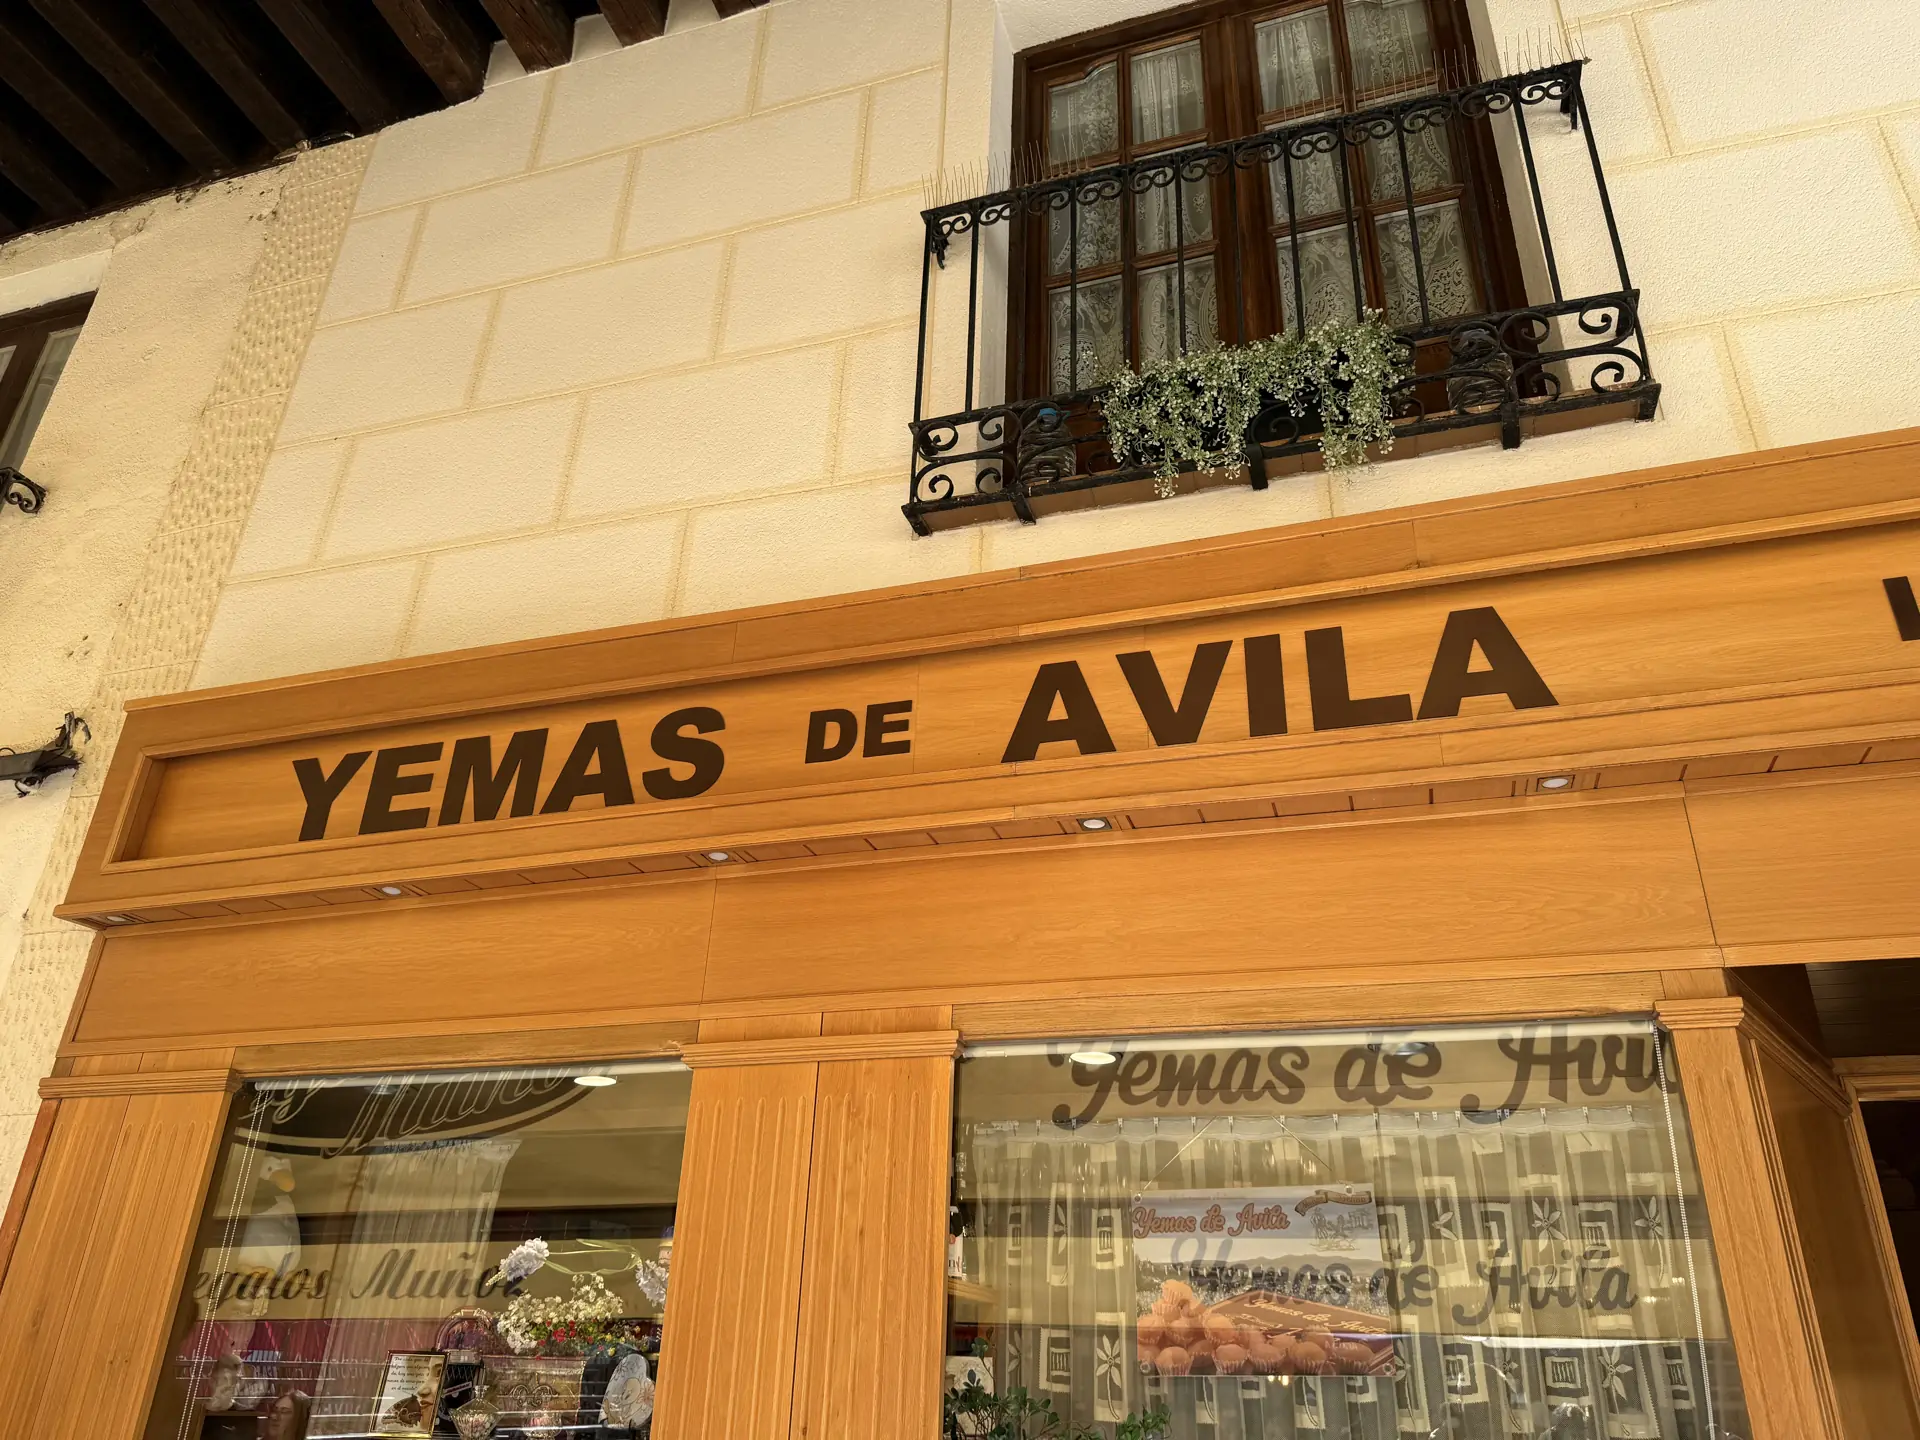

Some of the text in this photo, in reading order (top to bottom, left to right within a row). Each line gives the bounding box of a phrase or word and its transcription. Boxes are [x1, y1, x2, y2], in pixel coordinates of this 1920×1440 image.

[292, 605, 1560, 842] YEMAS DE AVILA
[1047, 1042, 1309, 1130] Yemas
[1334, 1032, 1441, 1107] de
[1133, 1206, 1197, 1239] Yemas
[1200, 1203, 1226, 1232] de
[1228, 1202, 1290, 1236] Avila
[193, 1251, 333, 1312] egalos
